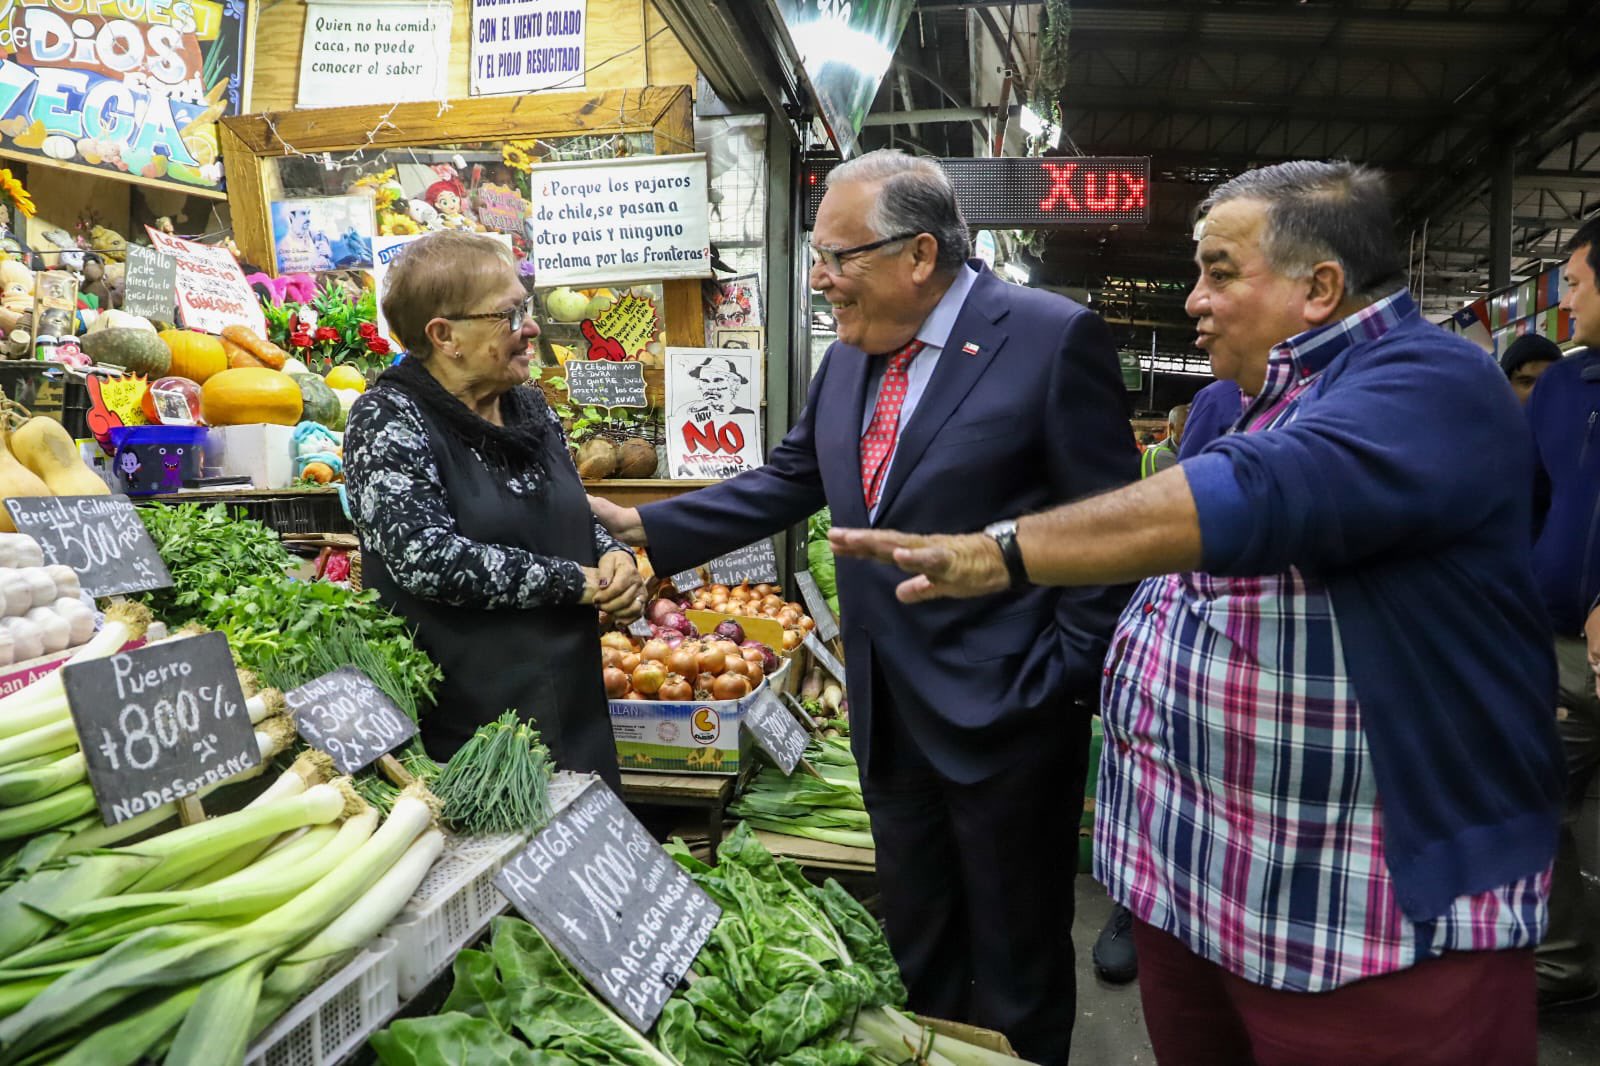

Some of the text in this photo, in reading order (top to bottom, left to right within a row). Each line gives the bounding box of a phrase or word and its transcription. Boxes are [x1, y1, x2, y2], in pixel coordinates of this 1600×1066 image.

[315, 17, 352, 32] Quien
[356, 22, 372, 32] no
[376, 19, 391, 32] ha
[479, 9, 581, 43] CON EL VIENTO COLADO
[314, 40, 416, 54] caca, no puede
[312, 61, 423, 75] conocer el sabor
[478, 46, 581, 79] Y EL PIOJO RESUCITADO
[608, 176, 629, 193] los
[634, 175, 691, 194] pajaros
[537, 205, 554, 221] de
[619, 200, 665, 219] pasan
[668, 200, 680, 212] a
[536, 228, 568, 245] otro
[572, 226, 603, 245] pais
[620, 223, 684, 241] ninguno
[538, 251, 592, 270] reclama
[596, 251, 618, 267] por
[621, 247, 639, 264] las
[569, 363, 581, 371] LA
[682, 420, 745, 455] NO
[678, 463, 694, 477] A
[111, 653, 192, 700] Puerro
